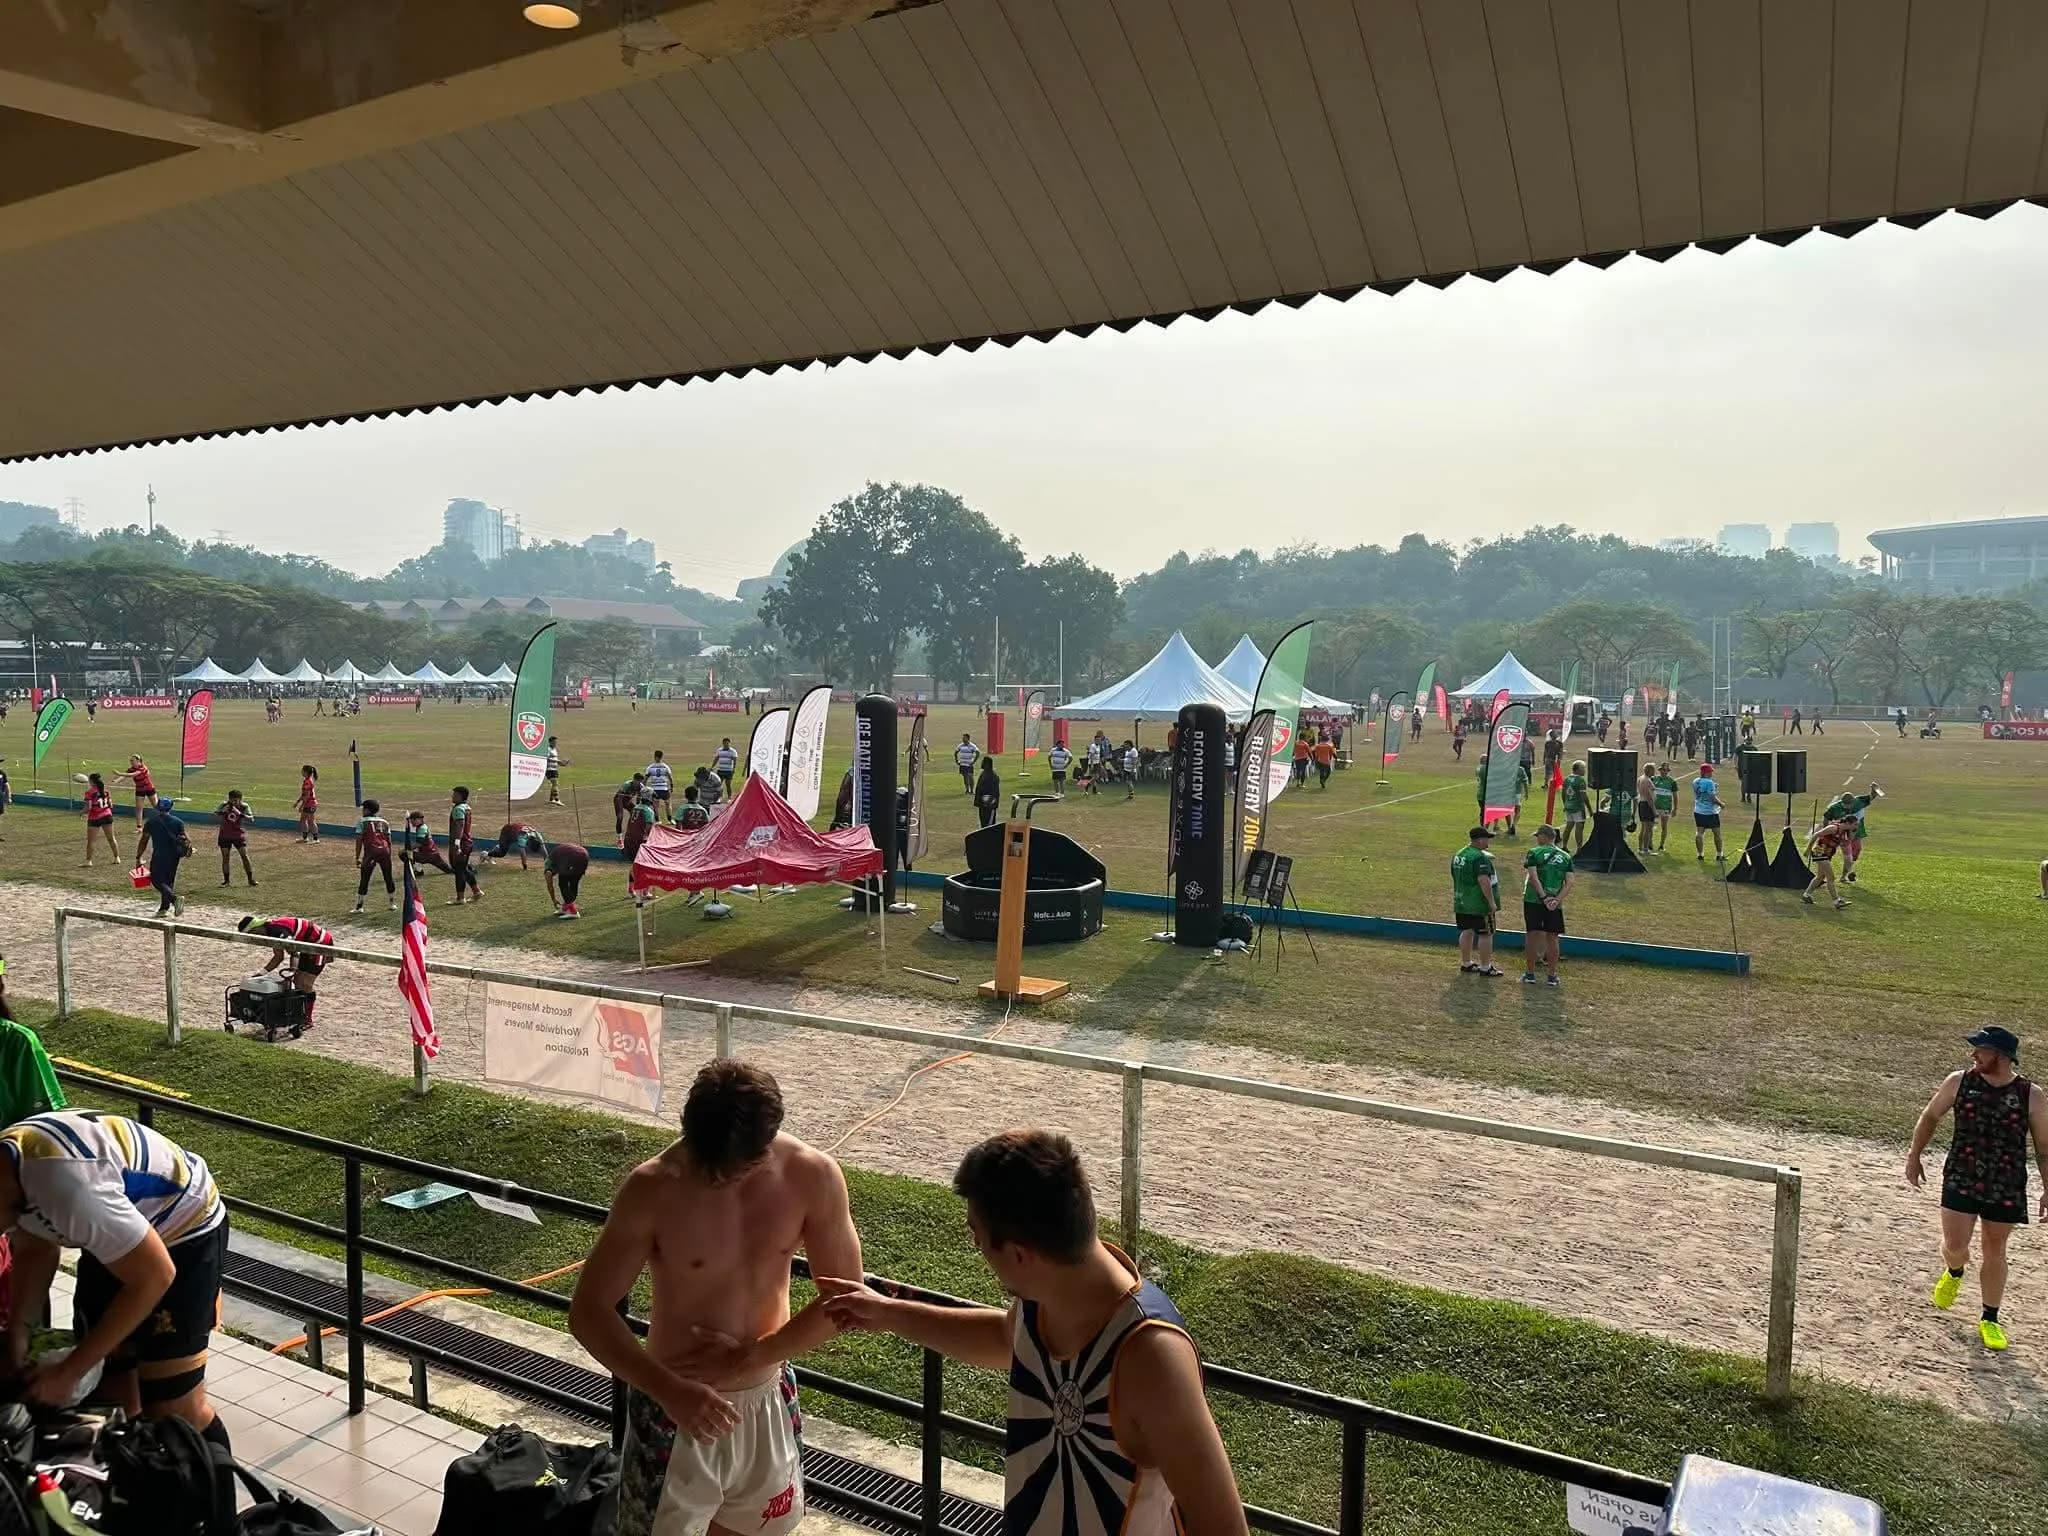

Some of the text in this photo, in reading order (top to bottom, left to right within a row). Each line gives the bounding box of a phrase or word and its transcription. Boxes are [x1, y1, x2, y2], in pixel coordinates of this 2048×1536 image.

[114, 699, 172, 707] POS MALAYSIA
[1191, 730, 1205, 839] RECOVERY ZONE
[1243, 734, 1265, 854] RECOVERY ZONE
